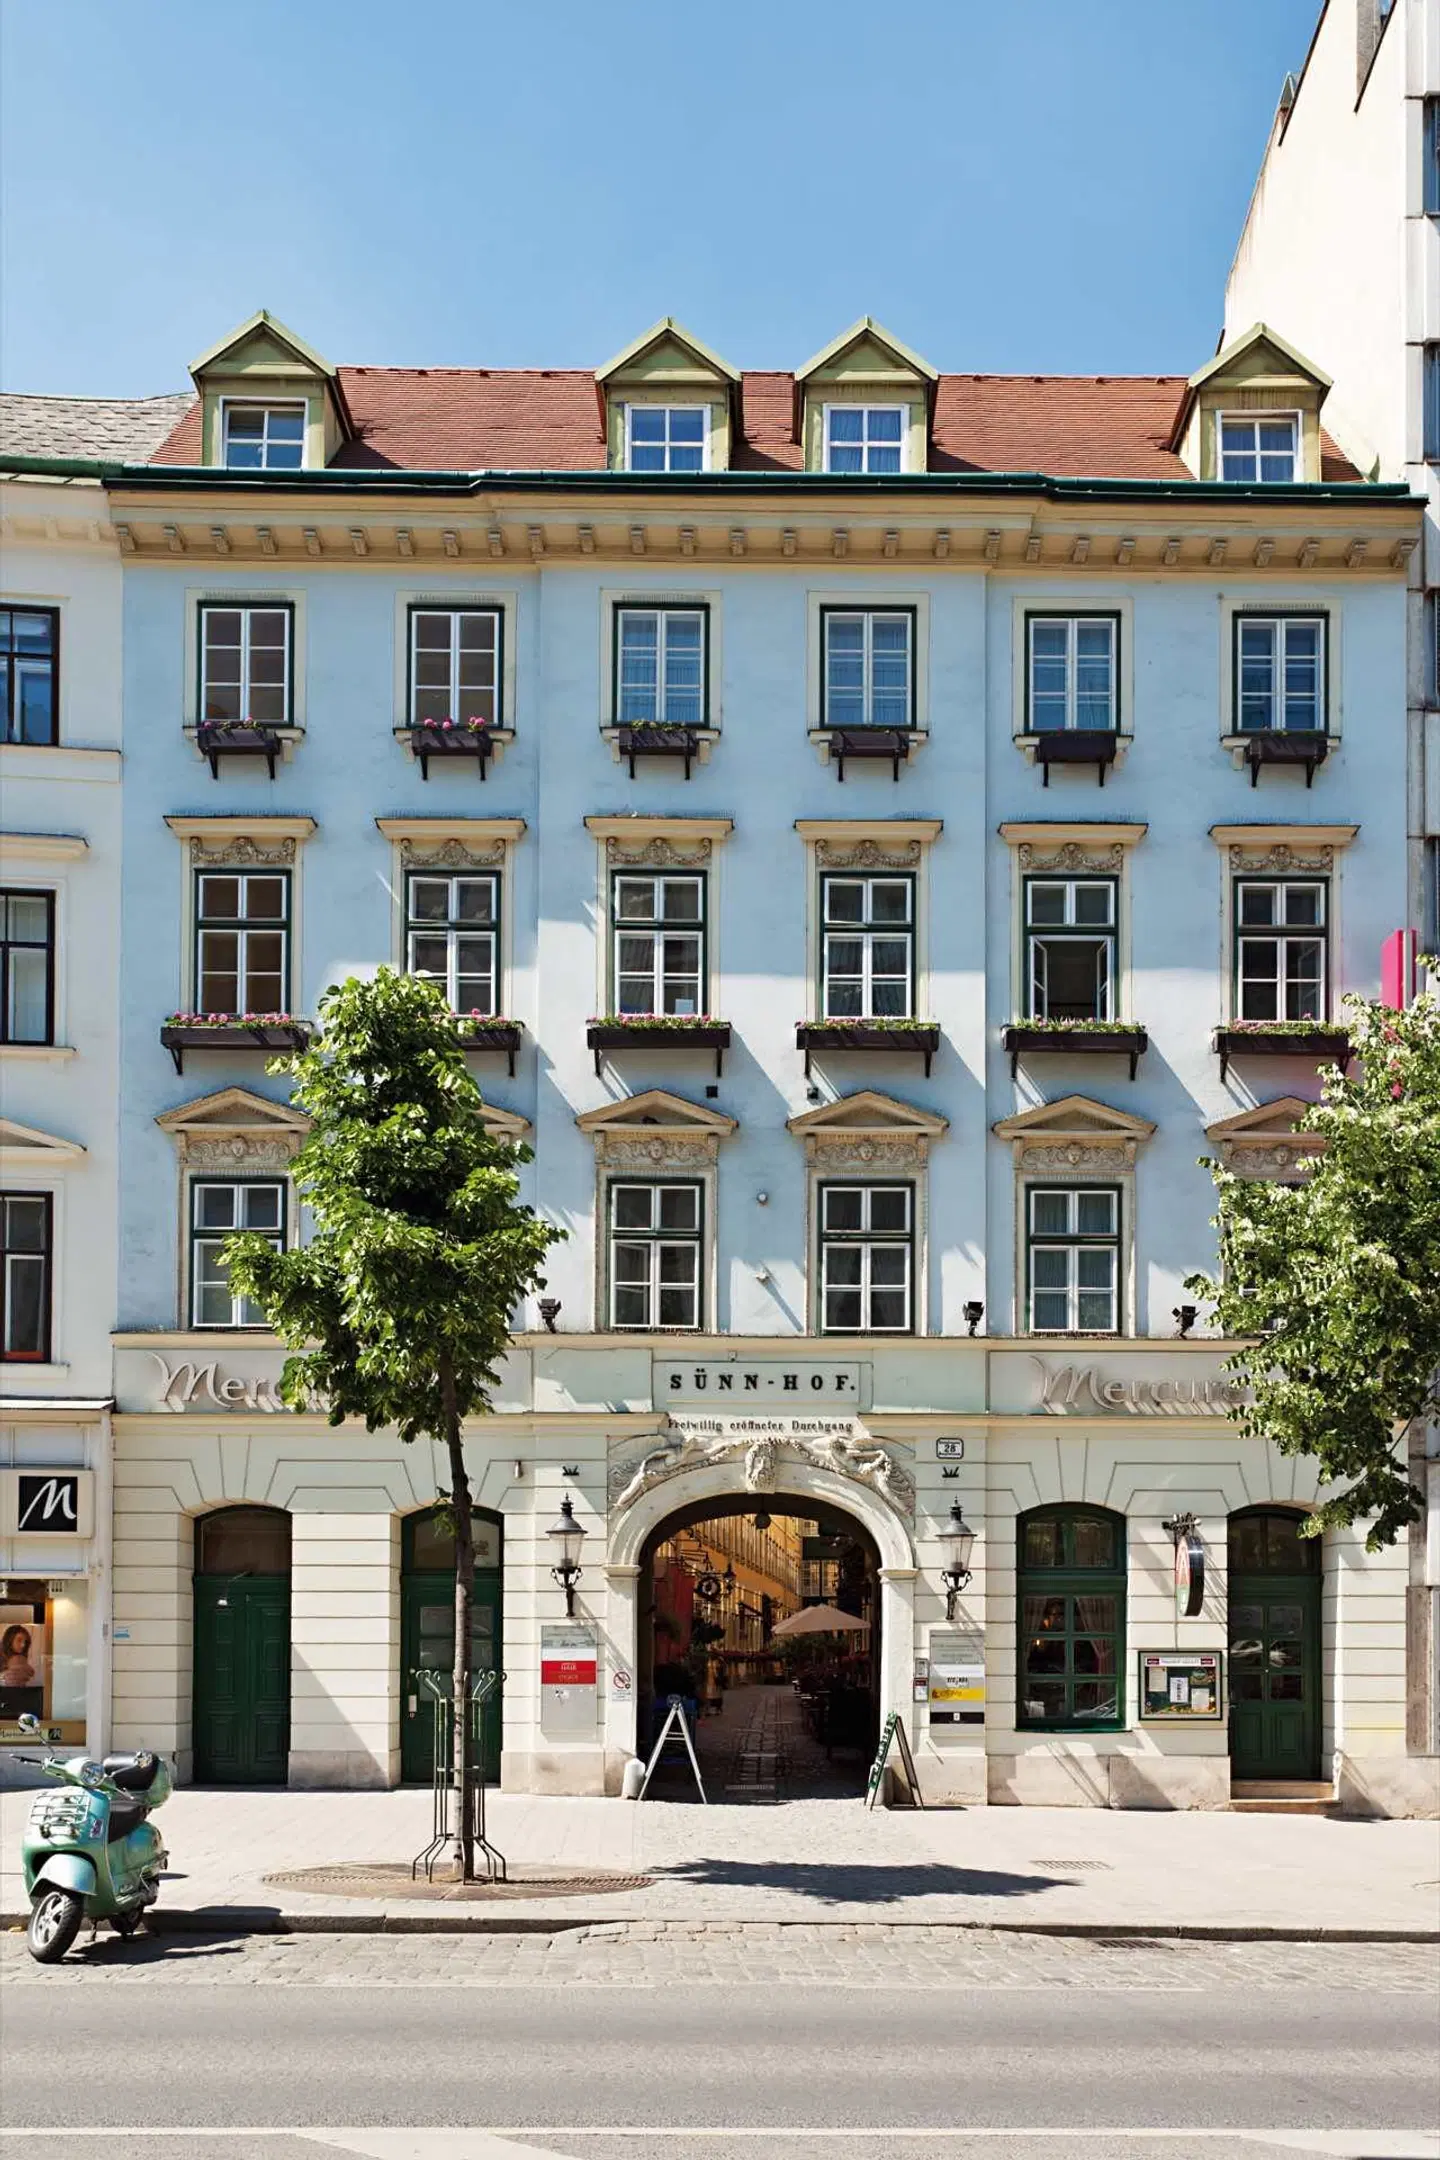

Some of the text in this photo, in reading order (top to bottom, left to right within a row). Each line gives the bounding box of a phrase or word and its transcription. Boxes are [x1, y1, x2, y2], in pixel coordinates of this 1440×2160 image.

[147, 1351, 284, 1408] Merc
[669, 1368, 856, 1391] SÜNN-HOF.
[944, 1444, 957, 1453] 28
[19, 1479, 77, 1529] M
